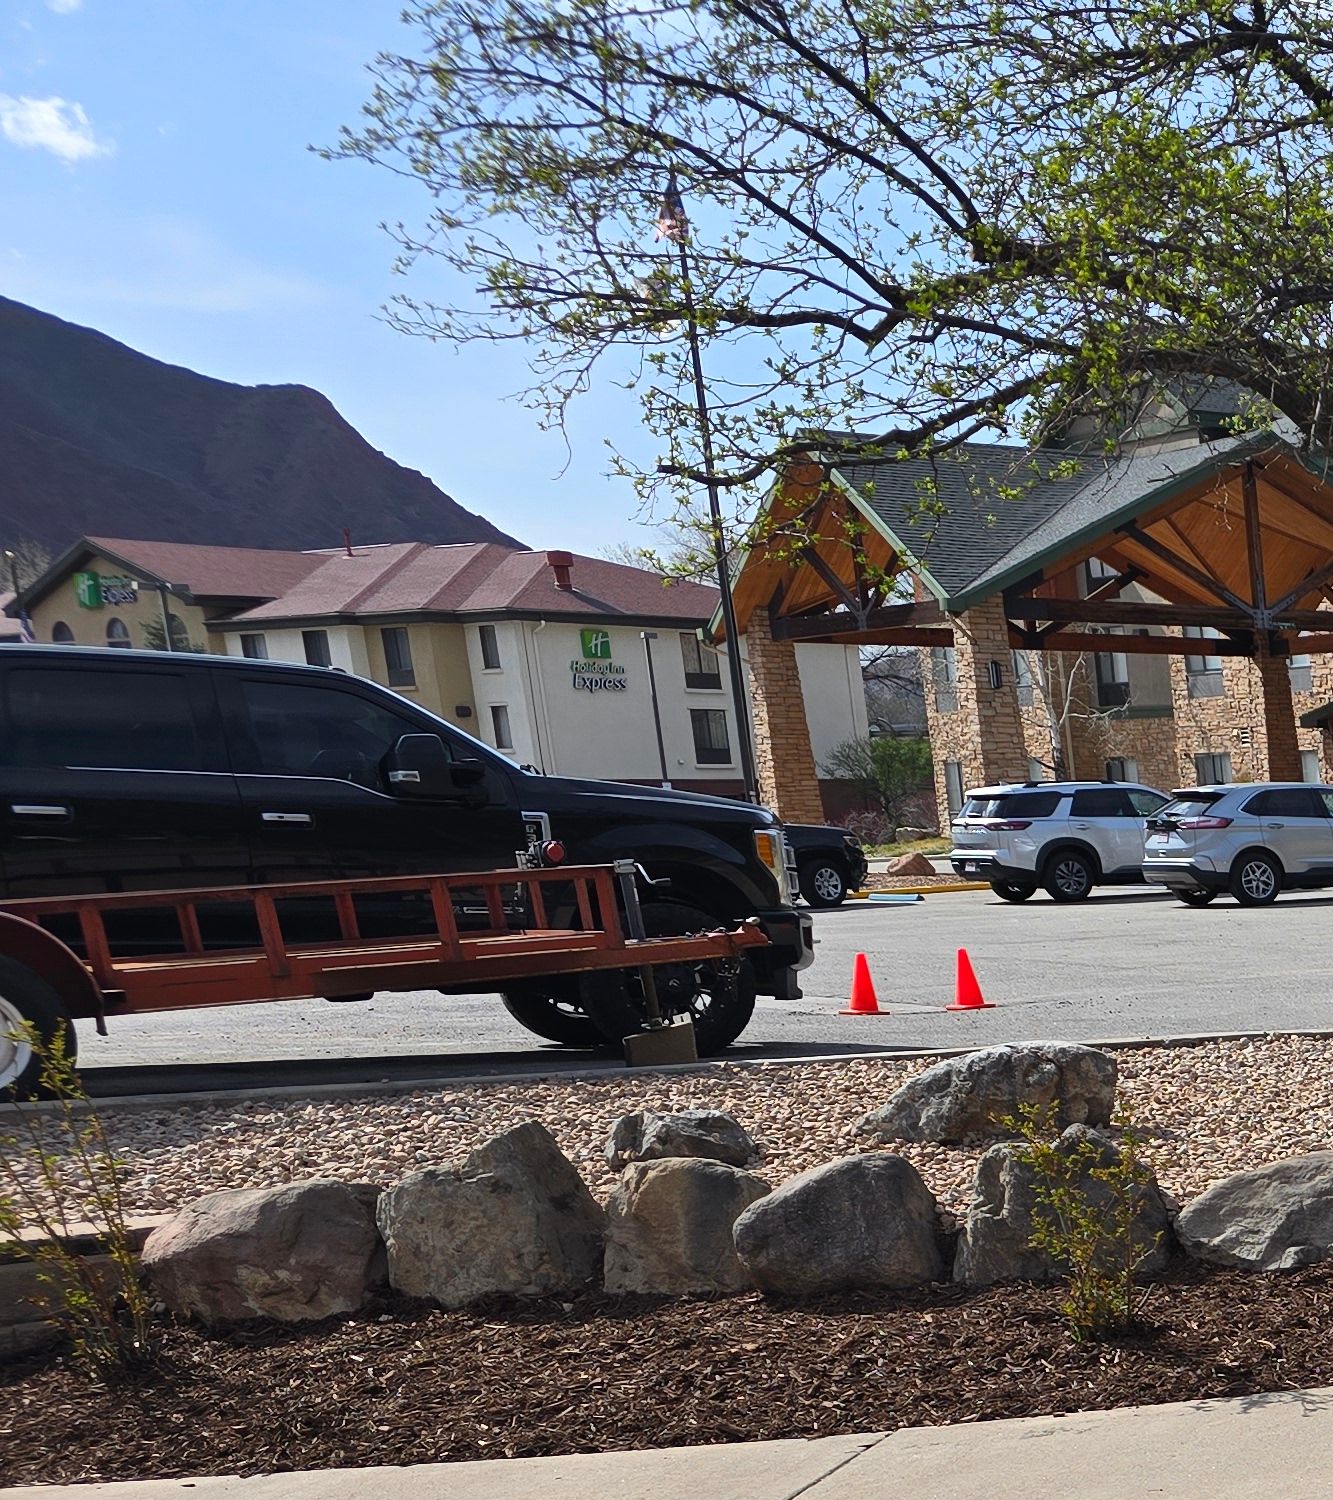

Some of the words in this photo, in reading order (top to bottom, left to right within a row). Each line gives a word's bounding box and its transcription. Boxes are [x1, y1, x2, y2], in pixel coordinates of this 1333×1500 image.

[571, 660, 609, 676] Holiday
[608, 662, 625, 674] Inn
[573, 673, 626, 693] Express
